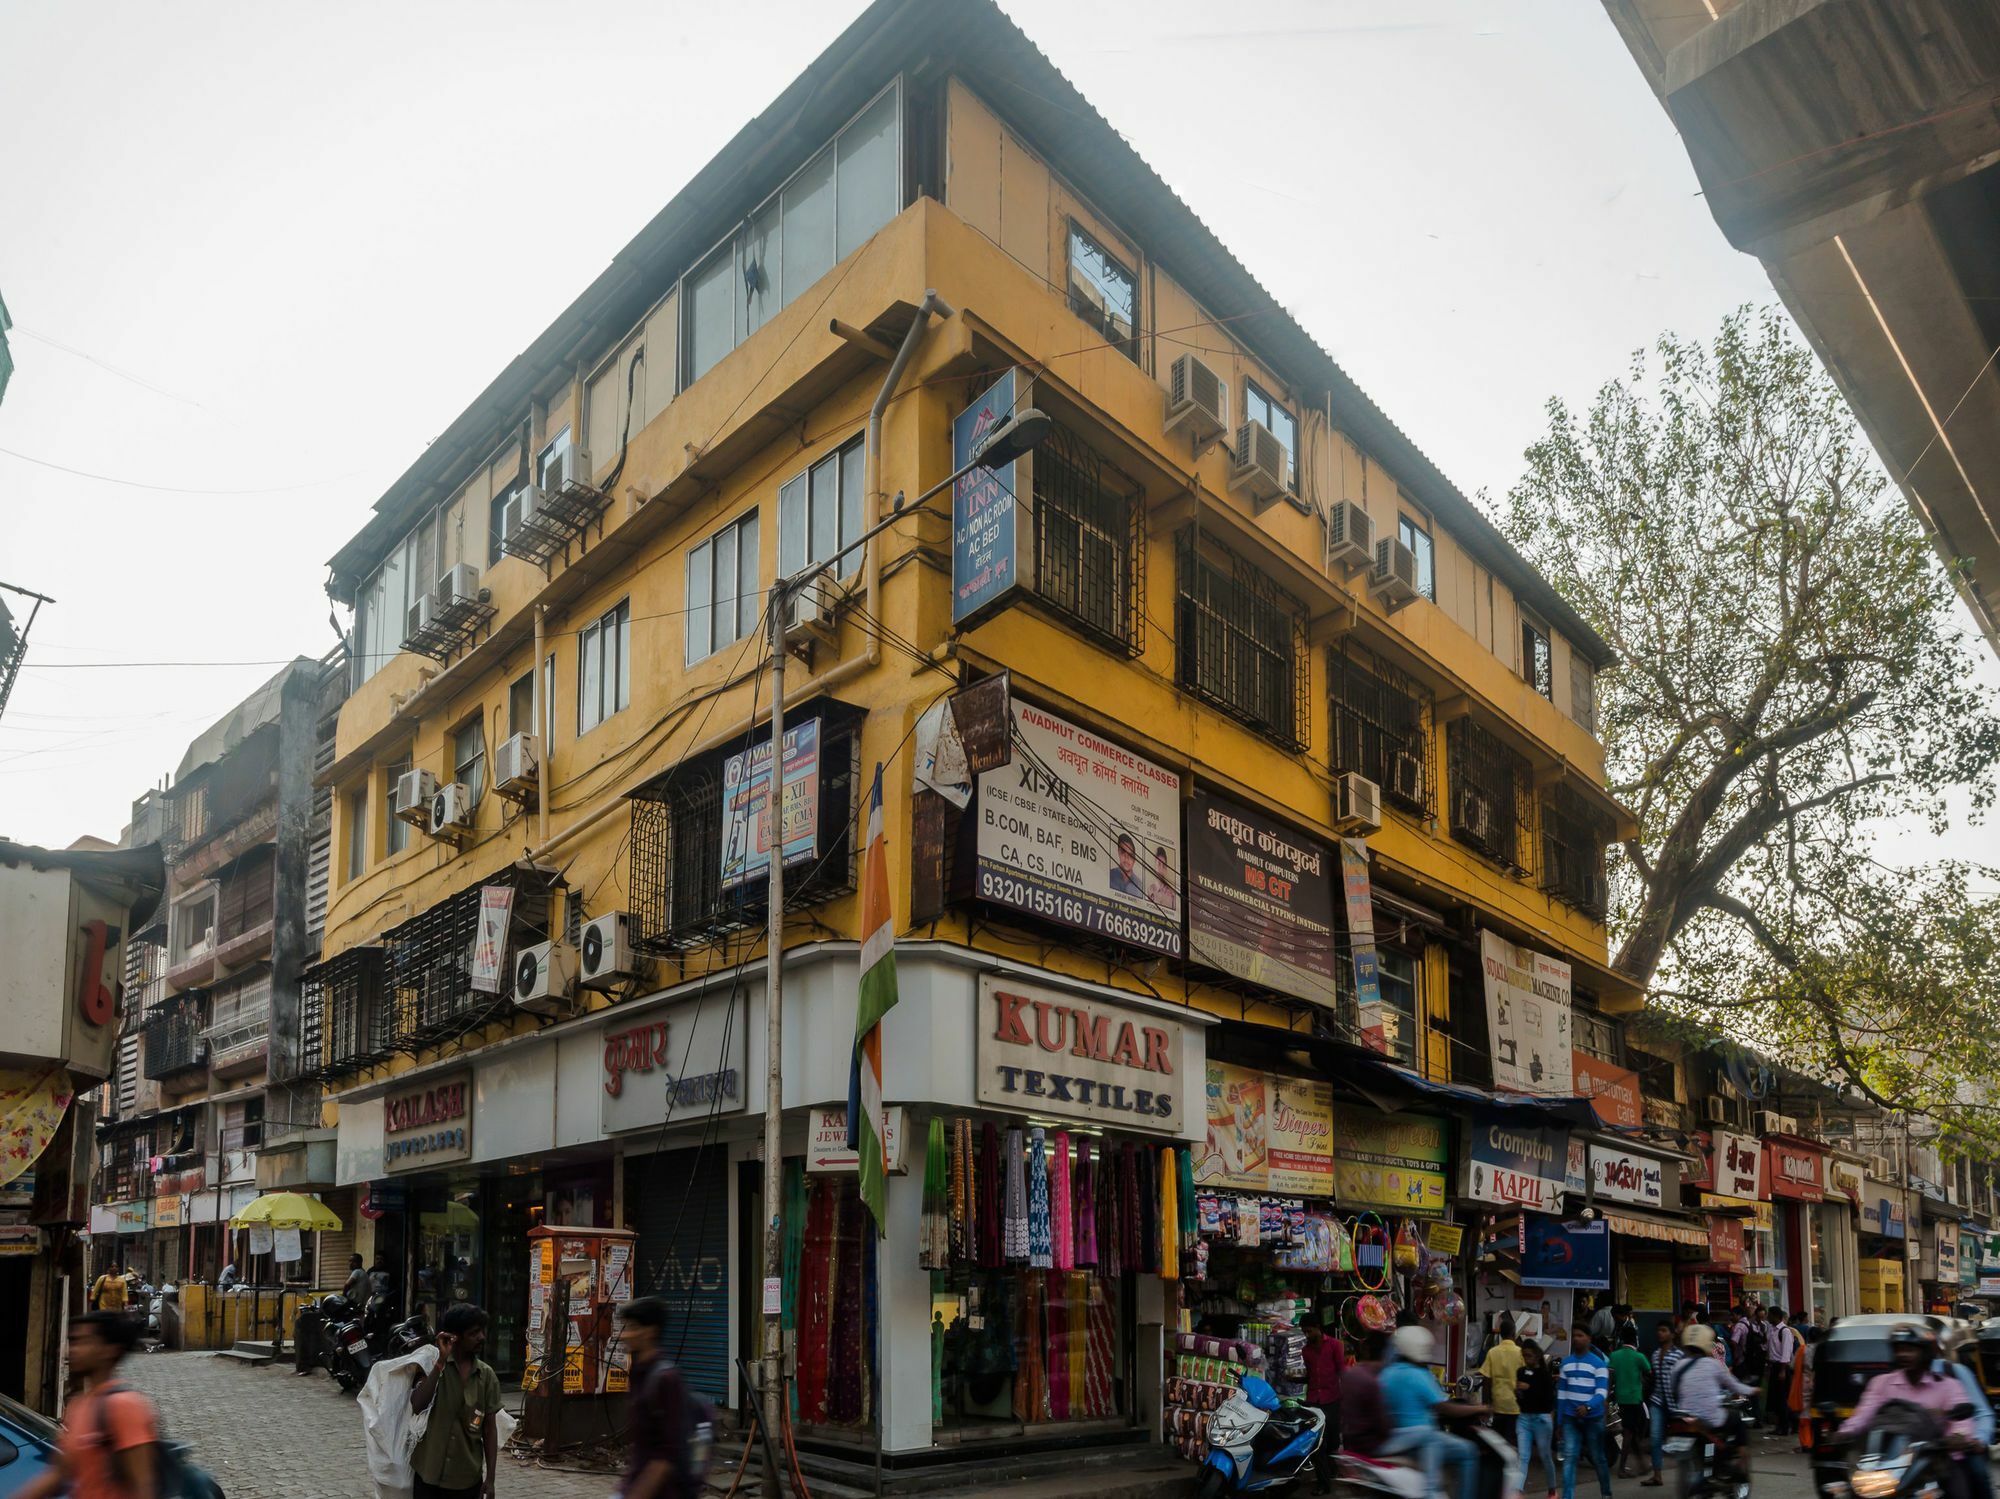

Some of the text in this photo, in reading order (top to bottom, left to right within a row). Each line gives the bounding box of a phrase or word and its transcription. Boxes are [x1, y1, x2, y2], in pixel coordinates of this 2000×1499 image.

[967, 479, 999, 518] INN
[993, 494, 1012, 518] ROOM
[968, 523, 1000, 558] AC BED
[747, 730, 798, 767] AVADUT
[1021, 708, 1074, 741] AVADHUT
[1078, 732, 1135, 769] COMMERCE
[1137, 763, 1178, 790] CLASSES
[1019, 763, 1069, 805] XI-XII
[1057, 745, 1150, 800] अवधूत कॉमर्स क्लासेस
[986, 784, 1008, 804] (ICSE
[1014, 793, 1036, 812] CBSE
[1043, 805, 1066, 825] STATE
[1067, 814, 1097, 837] BOARD)
[1142, 808, 1159, 821] TOPPER
[1208, 808, 1254, 846] अवधूत
[985, 809, 1097, 863] B.COM, BAF, BMS
[1001, 844, 1023, 868] CA,
[1027, 854, 1048, 877] CS,
[1052, 867, 1083, 886] ICWA
[1236, 848, 1299, 884] AVADHUT COMPUTERS
[1245, 865, 1265, 891] MS
[1269, 877, 1292, 901] CIT
[983, 873, 1083, 923] 9320155166
[1096, 908, 1181, 953] 7666392270
[1199, 875, 1222, 894] VIKAS
[1224, 886, 1270, 914] COMMERCIAL
[1270, 906, 1296, 924] TYPING
[1296, 916, 1330, 937] INSTITUTE
[1532, 976, 1561, 1004] MACHINE
[995, 990, 1173, 1075] KUMAR
[604, 1020, 669, 1099] कुमार
[385, 1081, 465, 1132] KALASH
[998, 1065, 1172, 1119] TEXTILES
[1593, 1077, 1633, 1105] micromax
[1274, 1104, 1331, 1146] Diapers
[1617, 1104, 1635, 1123] care
[385, 1127, 465, 1163] JEWELLERS
[1489, 1124, 1552, 1162] Crompton
[1406, 1159, 1419, 1169] TOYS
[1425, 1162, 1440, 1171] GIFTS
[1493, 1167, 1544, 1205] KAPIL
[1716, 1233, 1738, 1249] cell care
